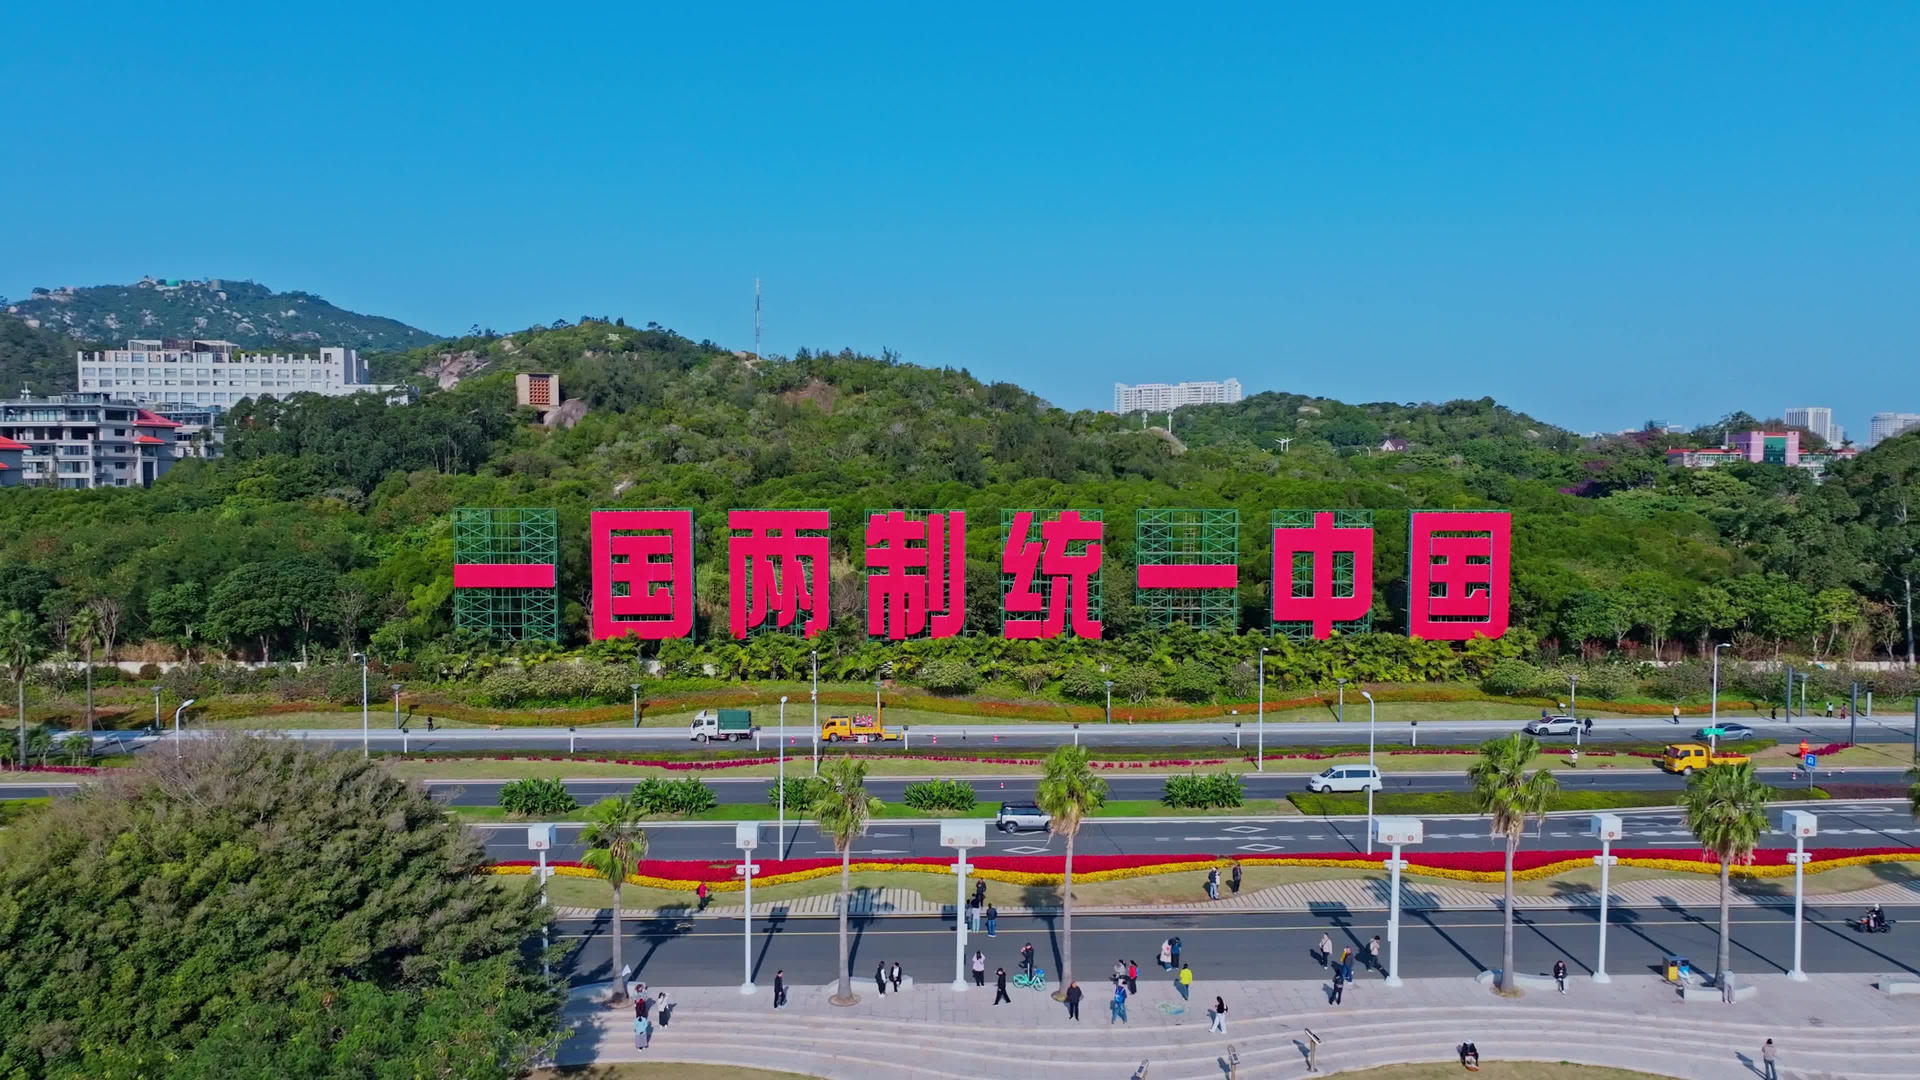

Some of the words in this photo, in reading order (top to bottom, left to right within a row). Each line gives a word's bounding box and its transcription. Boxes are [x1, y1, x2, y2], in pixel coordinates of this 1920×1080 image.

[453, 510, 1512, 641] 一国两制统一中国
